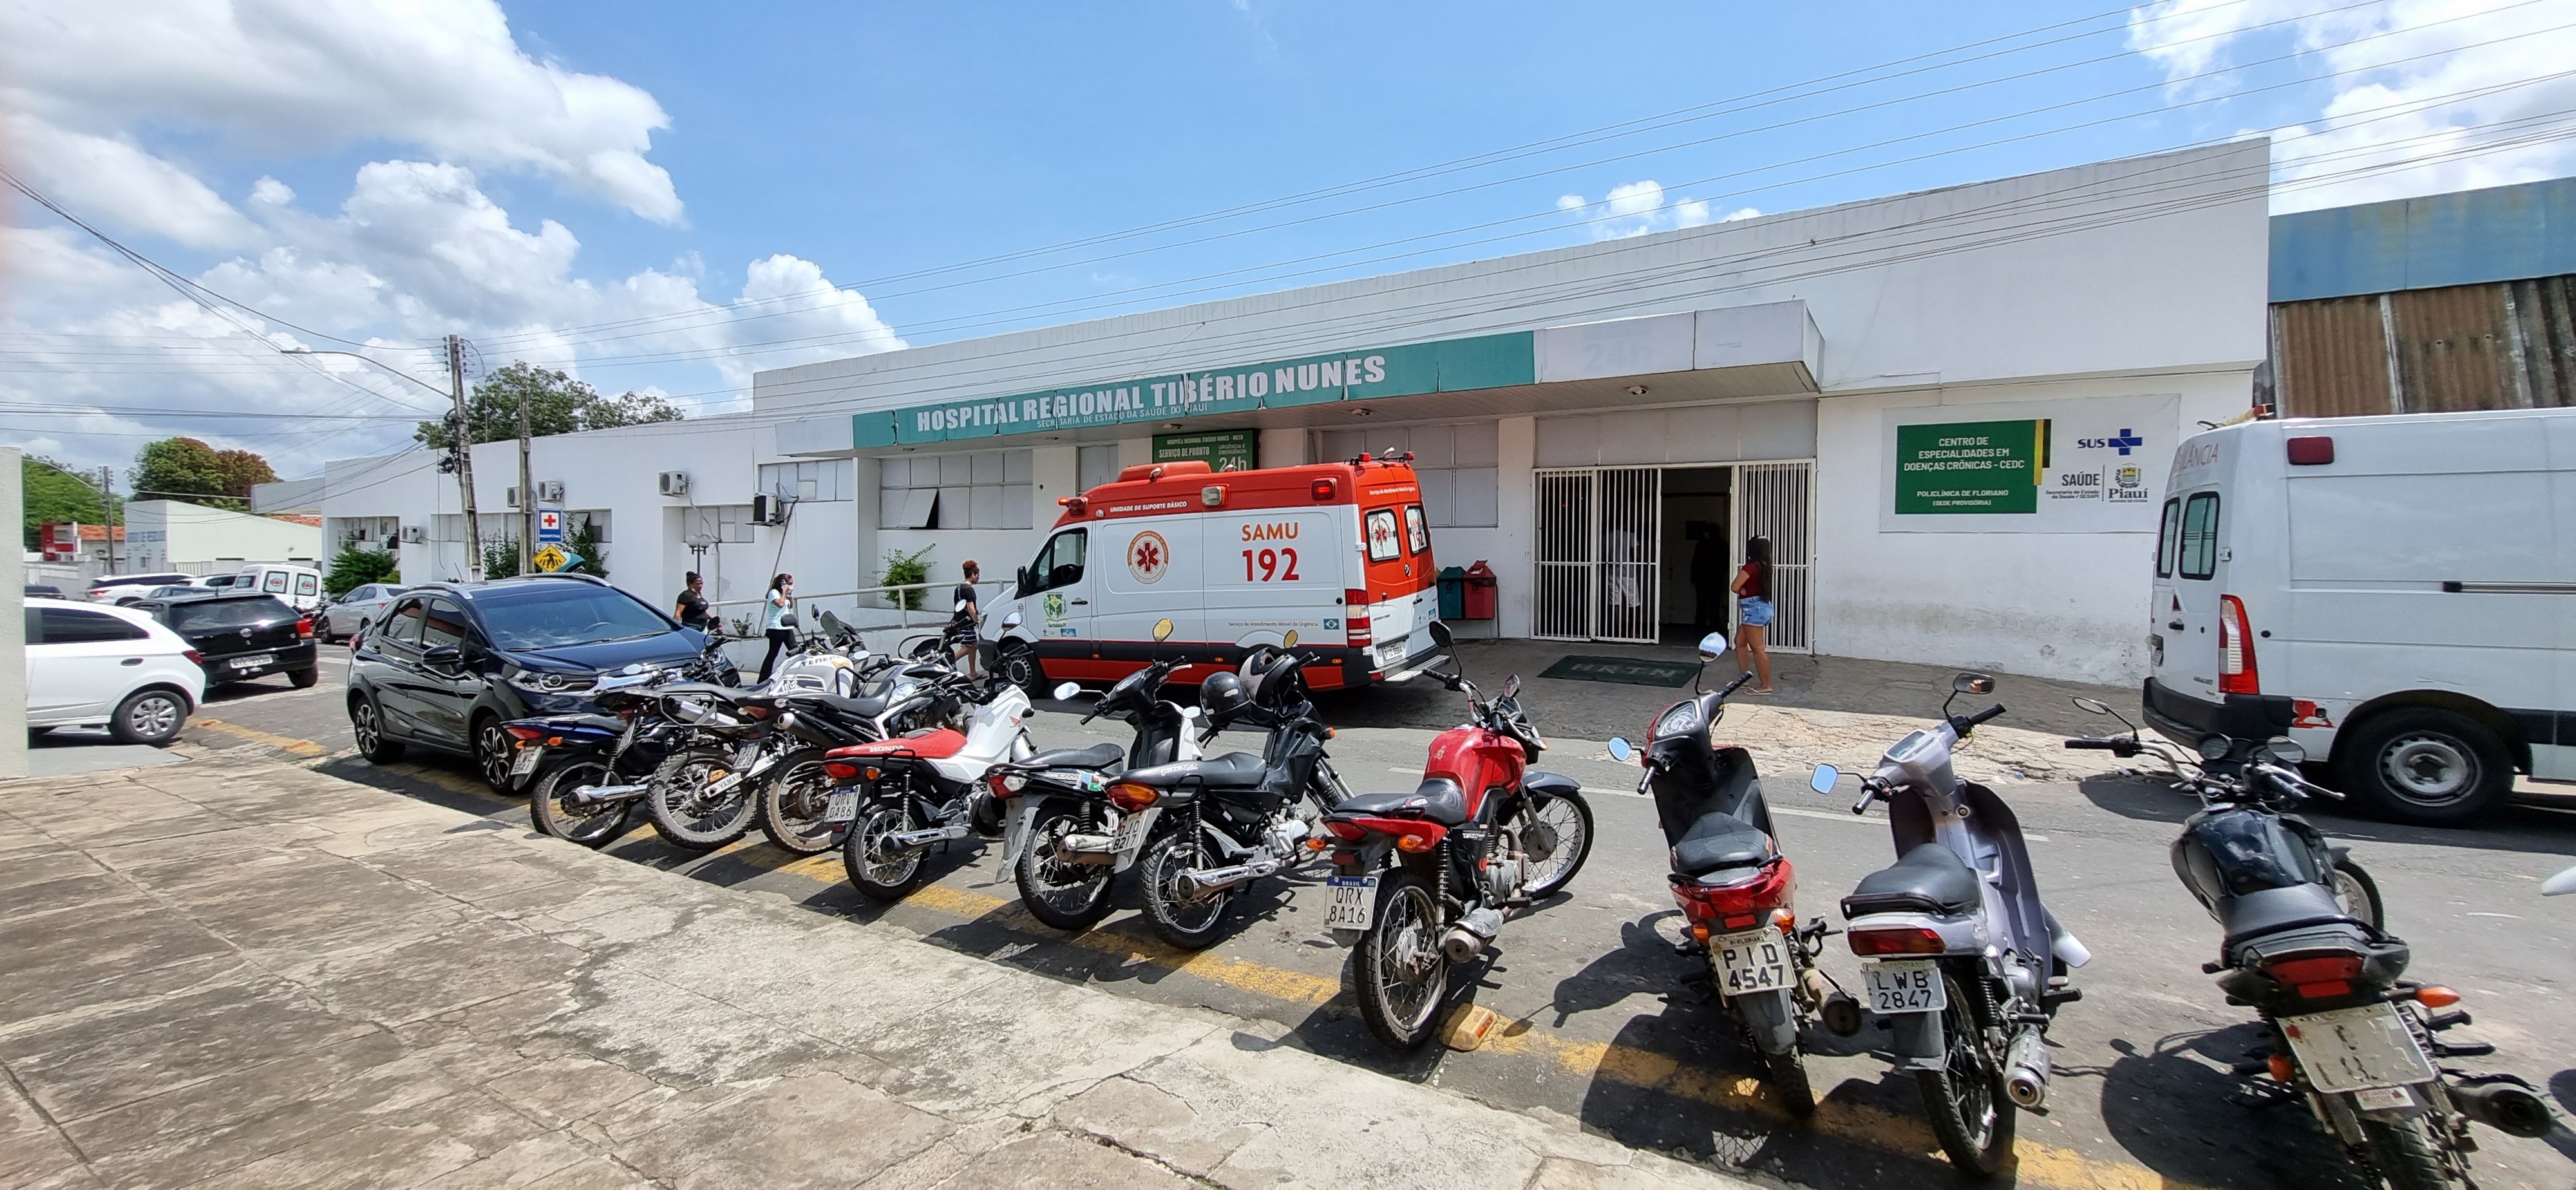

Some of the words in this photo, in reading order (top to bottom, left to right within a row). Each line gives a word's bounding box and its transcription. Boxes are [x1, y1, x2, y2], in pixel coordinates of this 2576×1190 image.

[917, 401, 1019, 431] HOSPITAL
[1023, 386, 1144, 421] REGIONAL
[1151, 371, 1268, 406] TIBÉRIO
[1275, 355, 1386, 394] NUNES
[1037, 417, 1080, 428] SECRETARIA
[1095, 413, 1124, 422] ESTADO
[1127, 410, 1138, 419] DA
[1139, 405, 1167, 417] SAÚDE
[1171, 404, 1181, 414] DO
[1938, 437, 1975, 447] CENTRO
[1976, 437, 1989, 446] DE
[2078, 438, 2105, 449] SUS
[1159, 448, 1181, 458] SERVIÇO
[1181, 448, 1189, 456] DE
[1189, 446, 1210, 456] PRONTO
[1918, 448, 1994, 459] ESPECIALIDADES
[1996, 448, 2009, 457] EM
[1904, 462, 1946, 472] DOENÇAS
[1946, 460, 1992, 470] CRÔNICAS
[2000, 460, 2025, 469] CEDC
[2061, 471, 2101, 486] SAÚDE
[2107, 487, 2148, 498] Piauí
[1242, 522, 1298, 542] SAMU
[1242, 548, 1299, 582] 192
[718, 773, 743, 789] YAMAH
[1113, 833, 1138, 850] 8217
[1336, 887, 1364, 905] QRX
[1329, 905, 1366, 923] 8A16
[1722, 943, 1779, 969] PID
[1728, 964, 1783, 990] 4547
[1875, 971, 1929, 990] LWB
[1878, 990, 1931, 1009] 2847
